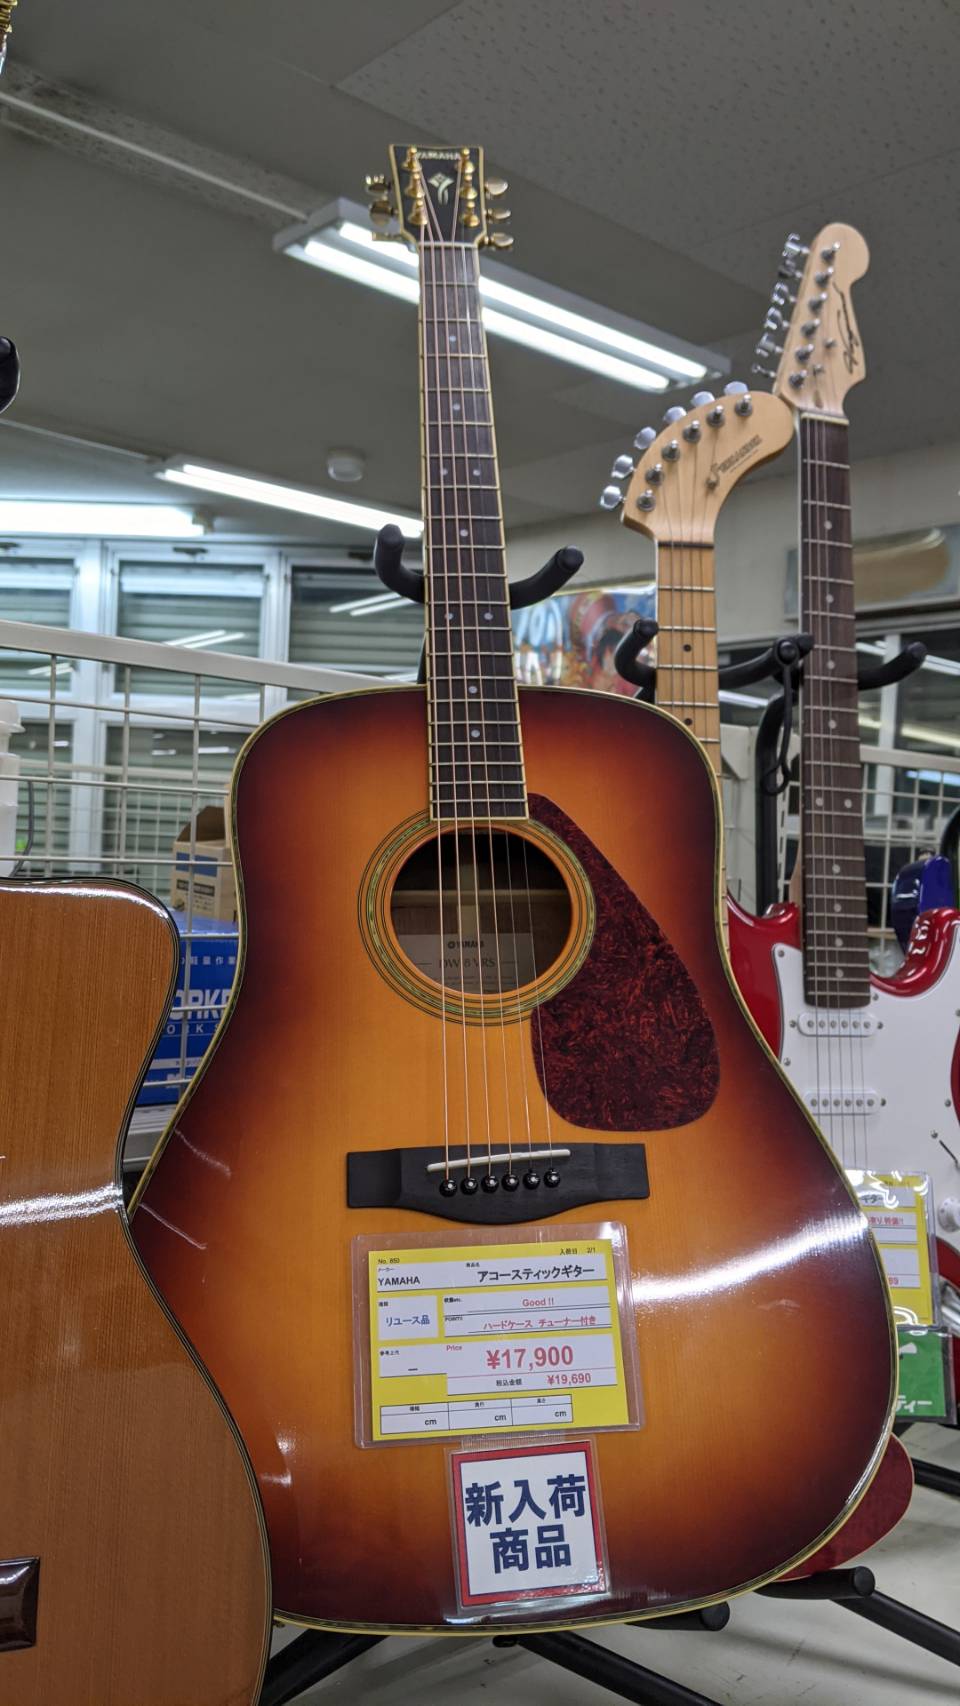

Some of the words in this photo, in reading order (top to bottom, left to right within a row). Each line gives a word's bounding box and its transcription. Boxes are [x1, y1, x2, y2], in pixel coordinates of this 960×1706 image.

[477, 1264, 596, 1283] アコースティックギター
[377, 1276, 421, 1287] YAMAHA
[522, 1298, 546, 1308] Good
[385, 1314, 431, 1327] リユース品
[482, 1318, 534, 1330] ハードケース
[537, 1314, 597, 1328] チューナー付き
[446, 1344, 463, 1352] Price
[485, 1345, 575, 1371] ¥17,900
[495, 1377, 523, 1387] 税込金額
[546, 1372, 592, 1386] ¥19,690
[494, 1413, 507, 1422] cm
[554, 1409, 568, 1418] cm
[424, 1418, 438, 1426] cm
[464, 1474, 586, 1527] 新入荷
[489, 1523, 572, 1574] 商品
